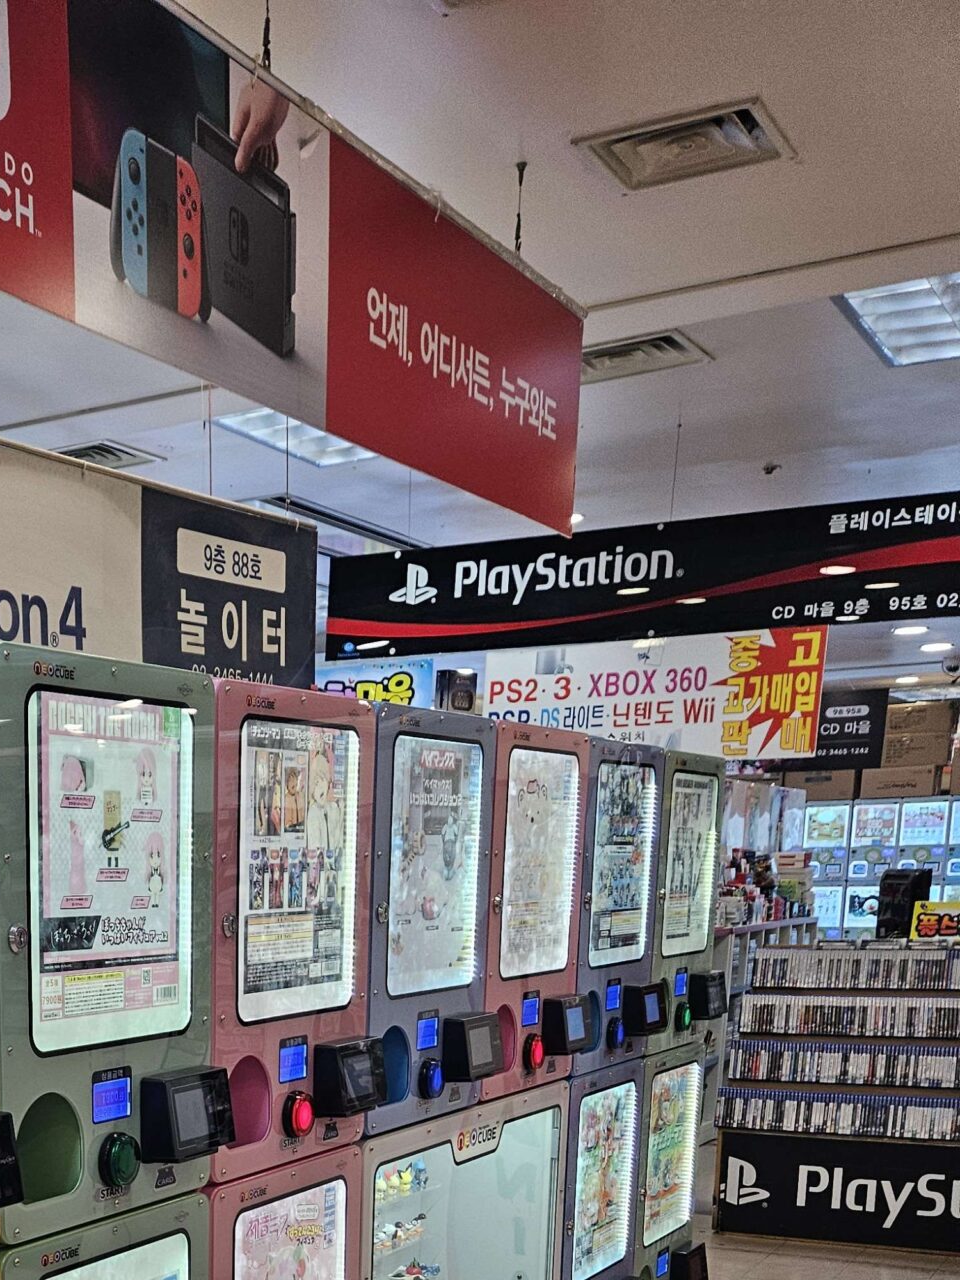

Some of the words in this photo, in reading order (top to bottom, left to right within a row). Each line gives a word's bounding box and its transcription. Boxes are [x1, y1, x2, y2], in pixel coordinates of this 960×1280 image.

[367, 287, 413, 367] 언제,
[420, 322, 494, 411] 어디서든,
[499, 366, 557, 441] 누구와도
[828, 501, 960, 534] 플레이스테이
[204, 543, 226, 575] 9층
[232, 550, 263, 581] 88호
[454, 547, 675, 606] PlayStation
[772, 606, 795, 619] CD
[804, 602, 835, 618] 마을
[843, 598, 870, 615] 9층
[889, 594, 928, 611] 95호
[936, 593, 960, 608] 02
[489, 678, 539, 704] PS2
[588, 669, 658, 698] XBOX
[664, 666, 708, 694] 360
[722, 671, 819, 715] 고가매입
[612, 700, 675, 728] 닌텐도
[683, 697, 716, 724] Wii
[820, 723, 840, 735] CD
[844, 720, 872, 734] 마을
[100, 1186, 125, 1200] START
[157, 1175, 175, 1186] CARD
